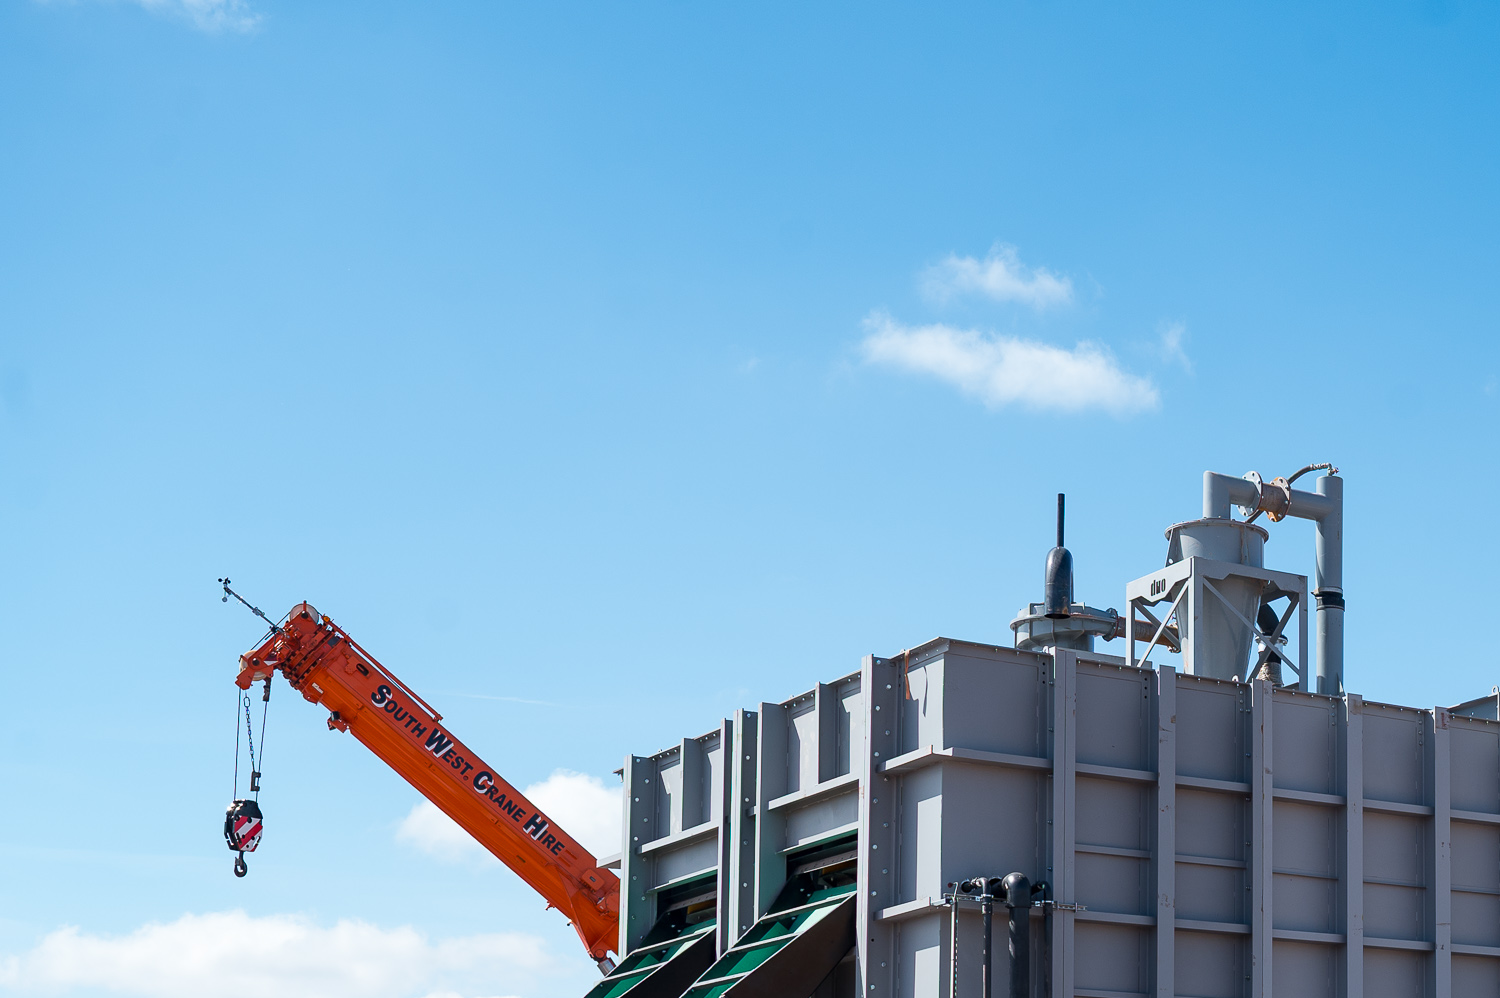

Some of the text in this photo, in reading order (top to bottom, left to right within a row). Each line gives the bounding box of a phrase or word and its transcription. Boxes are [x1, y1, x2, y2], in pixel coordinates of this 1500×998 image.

[371, 684, 428, 738] SOUTH
[473, 770, 527, 823] CRANE
[522, 812, 566, 857] HIRE
